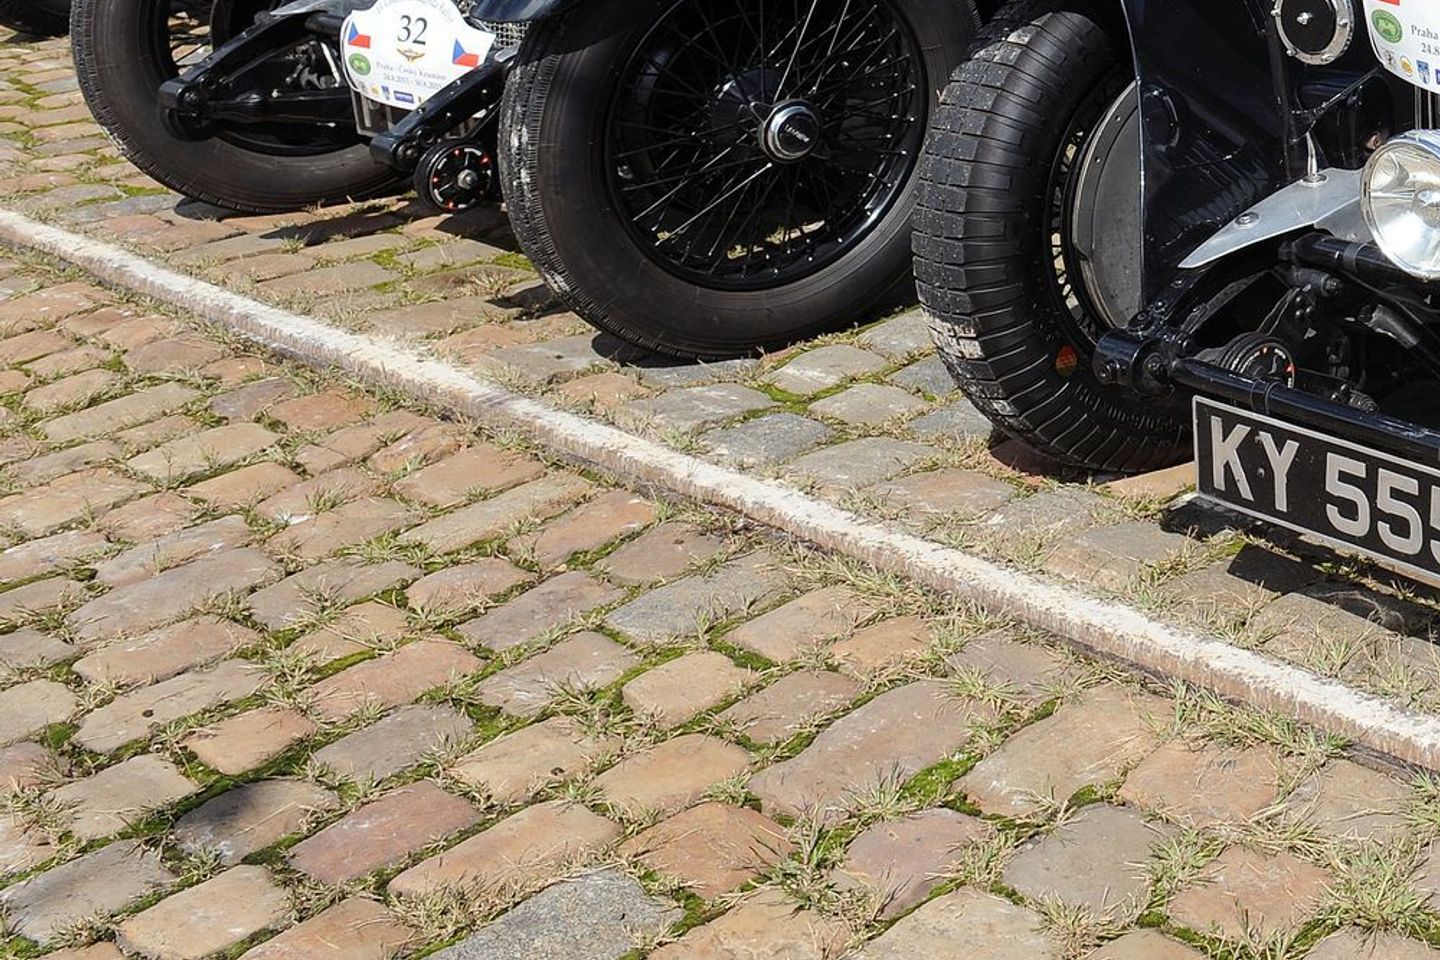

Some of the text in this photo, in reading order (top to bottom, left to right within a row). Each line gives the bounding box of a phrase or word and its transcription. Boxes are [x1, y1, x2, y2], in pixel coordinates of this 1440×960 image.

[397, 14, 428, 46] 32
[1411, 24, 1439, 41] Praha
[1211, 415, 1300, 513] KY
